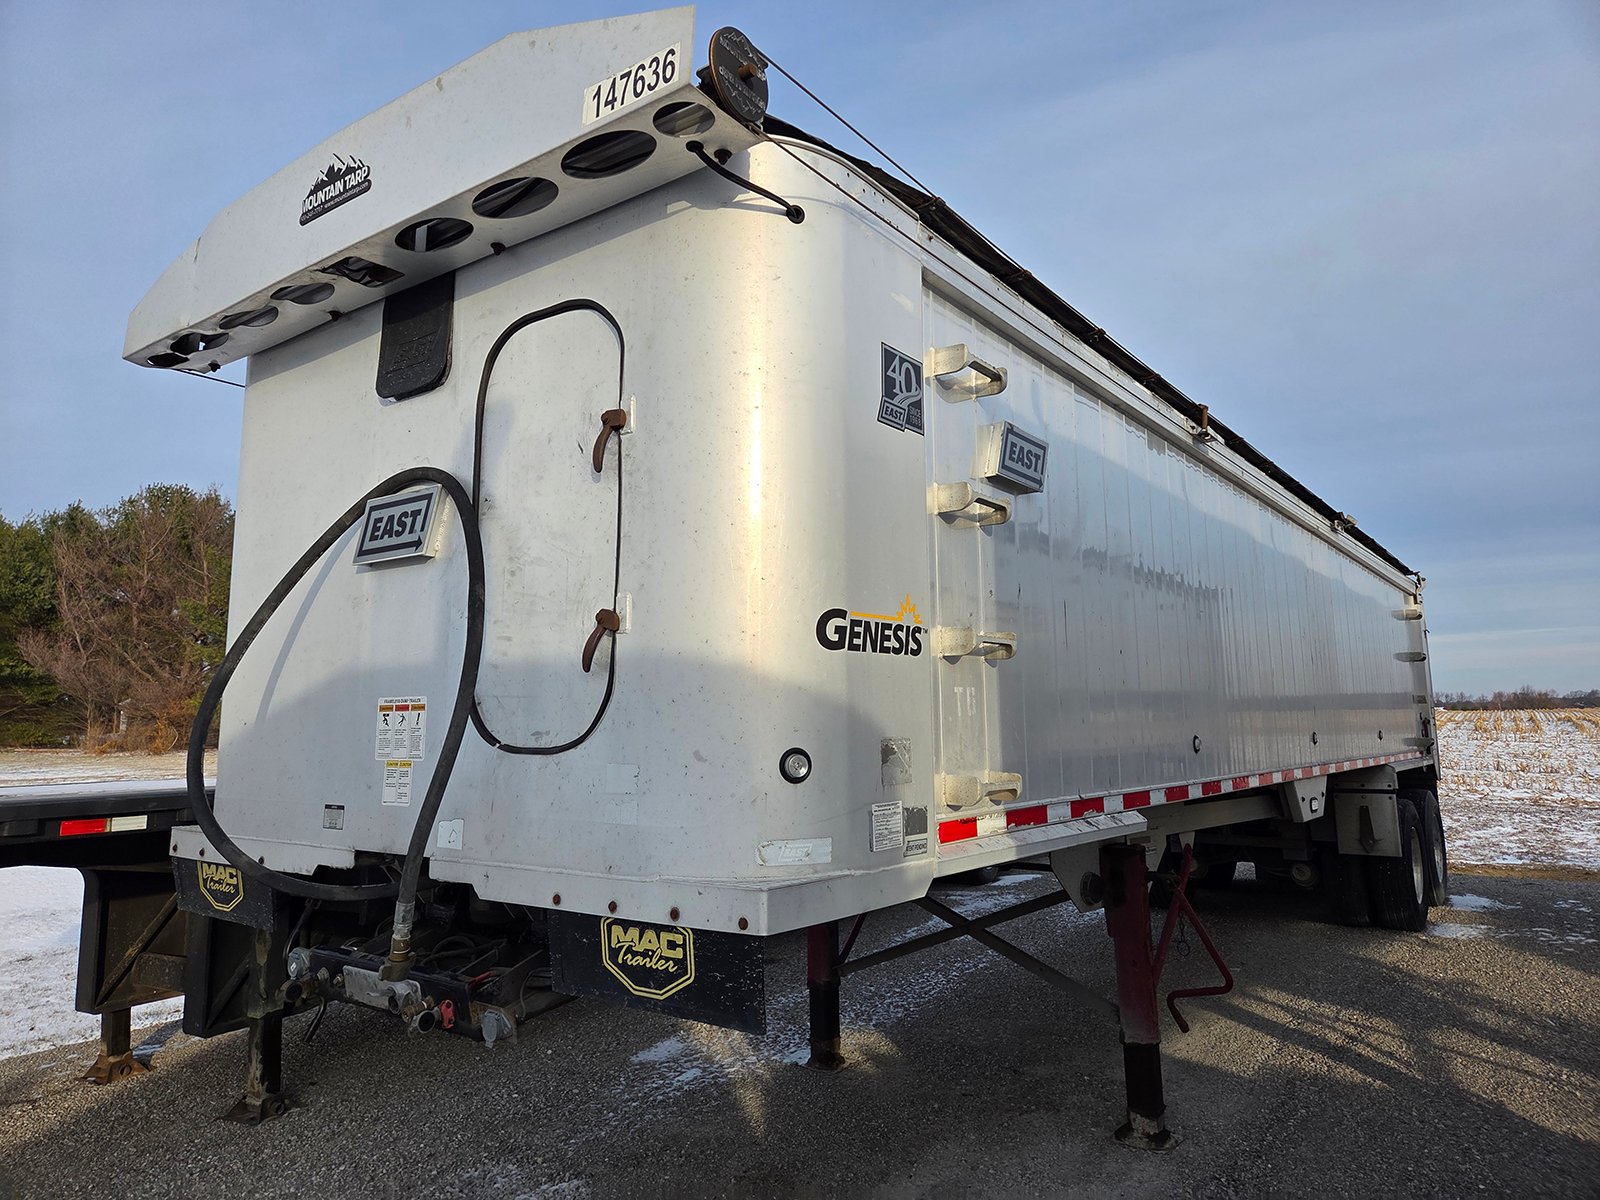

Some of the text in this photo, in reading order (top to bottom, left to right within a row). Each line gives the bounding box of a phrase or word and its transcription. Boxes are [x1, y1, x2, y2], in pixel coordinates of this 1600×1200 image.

[592, 48, 676, 118] 147636
[301, 178, 344, 213] MOUNTAIN
[345, 166, 368, 190] TARP
[887, 353, 918, 395] 40
[884, 405, 904, 421] EAST
[1008, 440, 1042, 473] EAST
[368, 508, 423, 542] EAST
[815, 607, 923, 657] GENESIS
[202, 862, 238, 885] MAC
[206, 874, 236, 894] Trailer
[611, 924, 684, 959] MAC
[615, 941, 678, 973] Trailer
